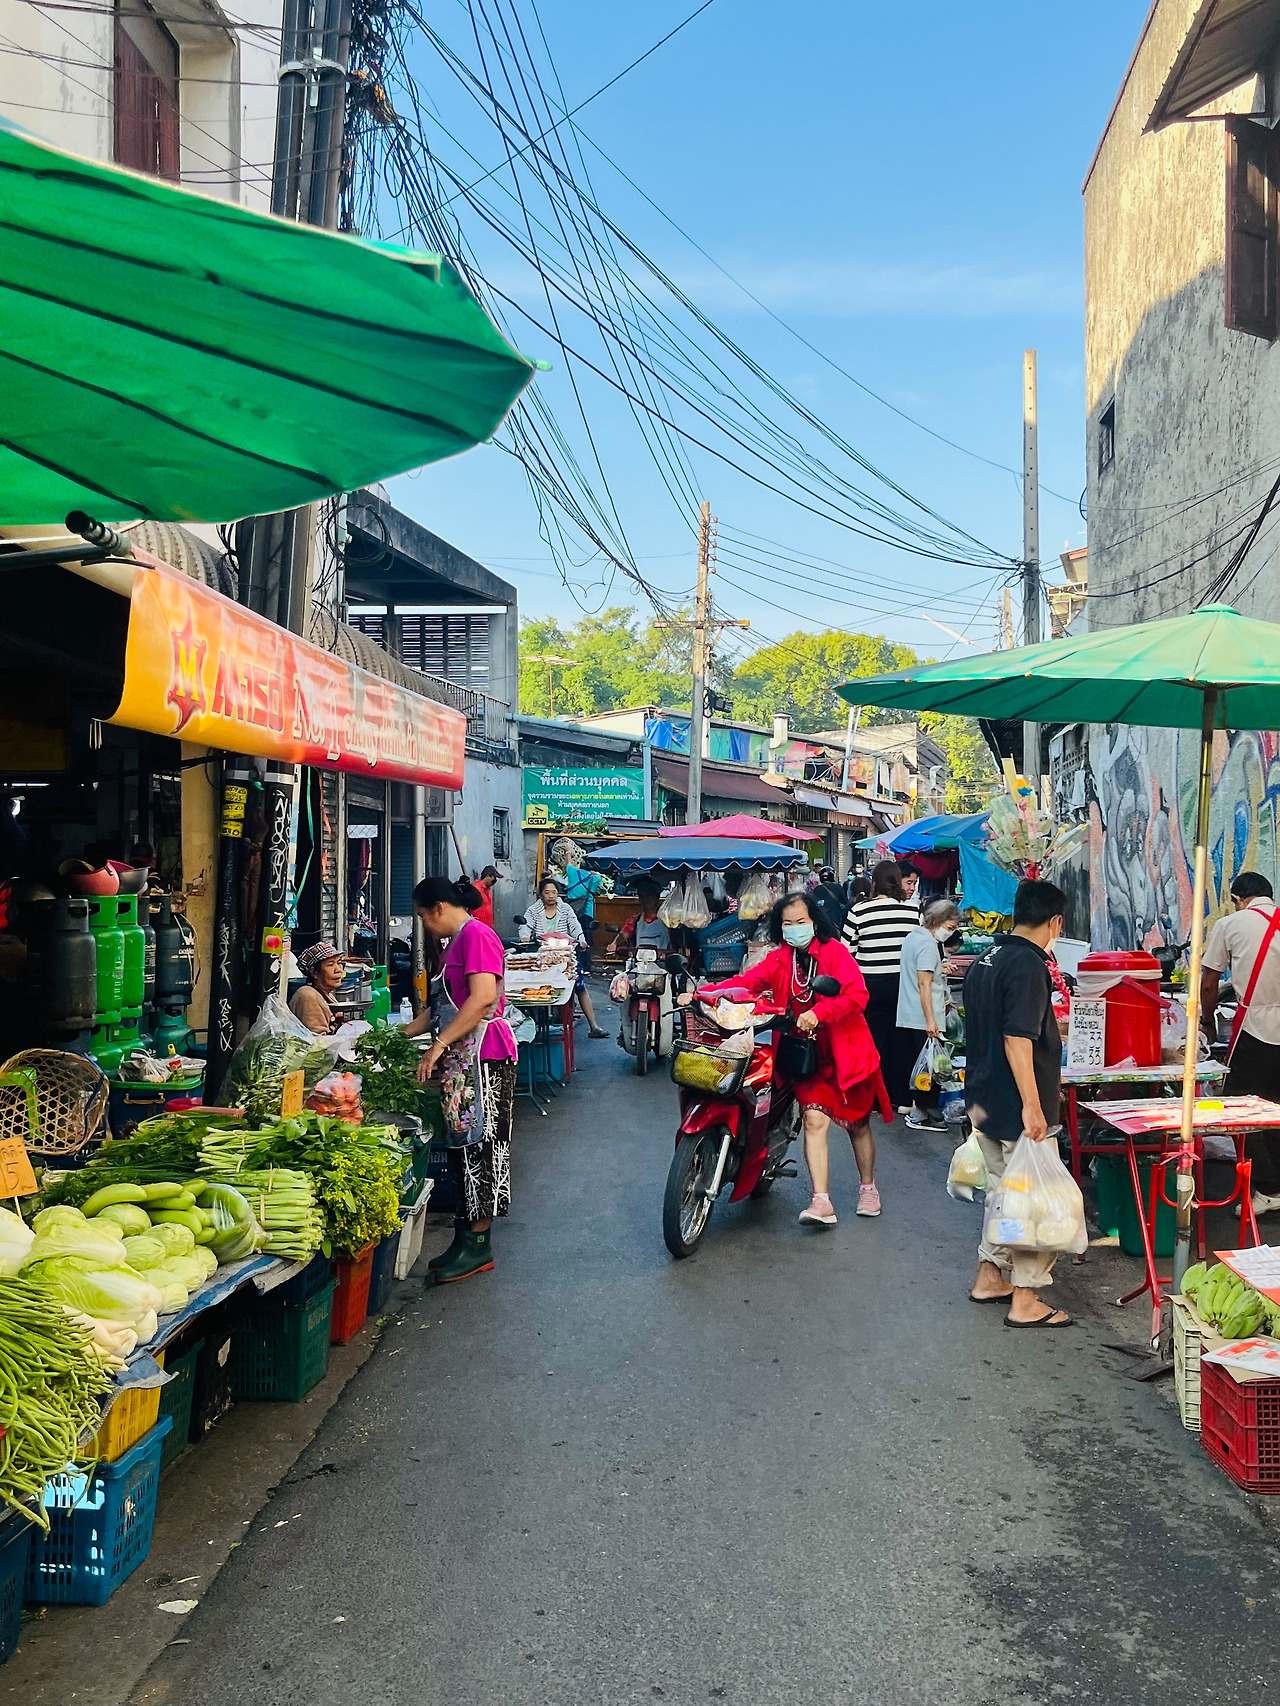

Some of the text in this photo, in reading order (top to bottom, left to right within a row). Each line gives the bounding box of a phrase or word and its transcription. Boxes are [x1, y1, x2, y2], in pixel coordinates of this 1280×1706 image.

[212, 651, 284, 732] M-150
[344, 713, 379, 767] energy
[406, 722, 418, 766] in
[540, 769, 628, 791] พื้นที่ส่วนบุคคล
